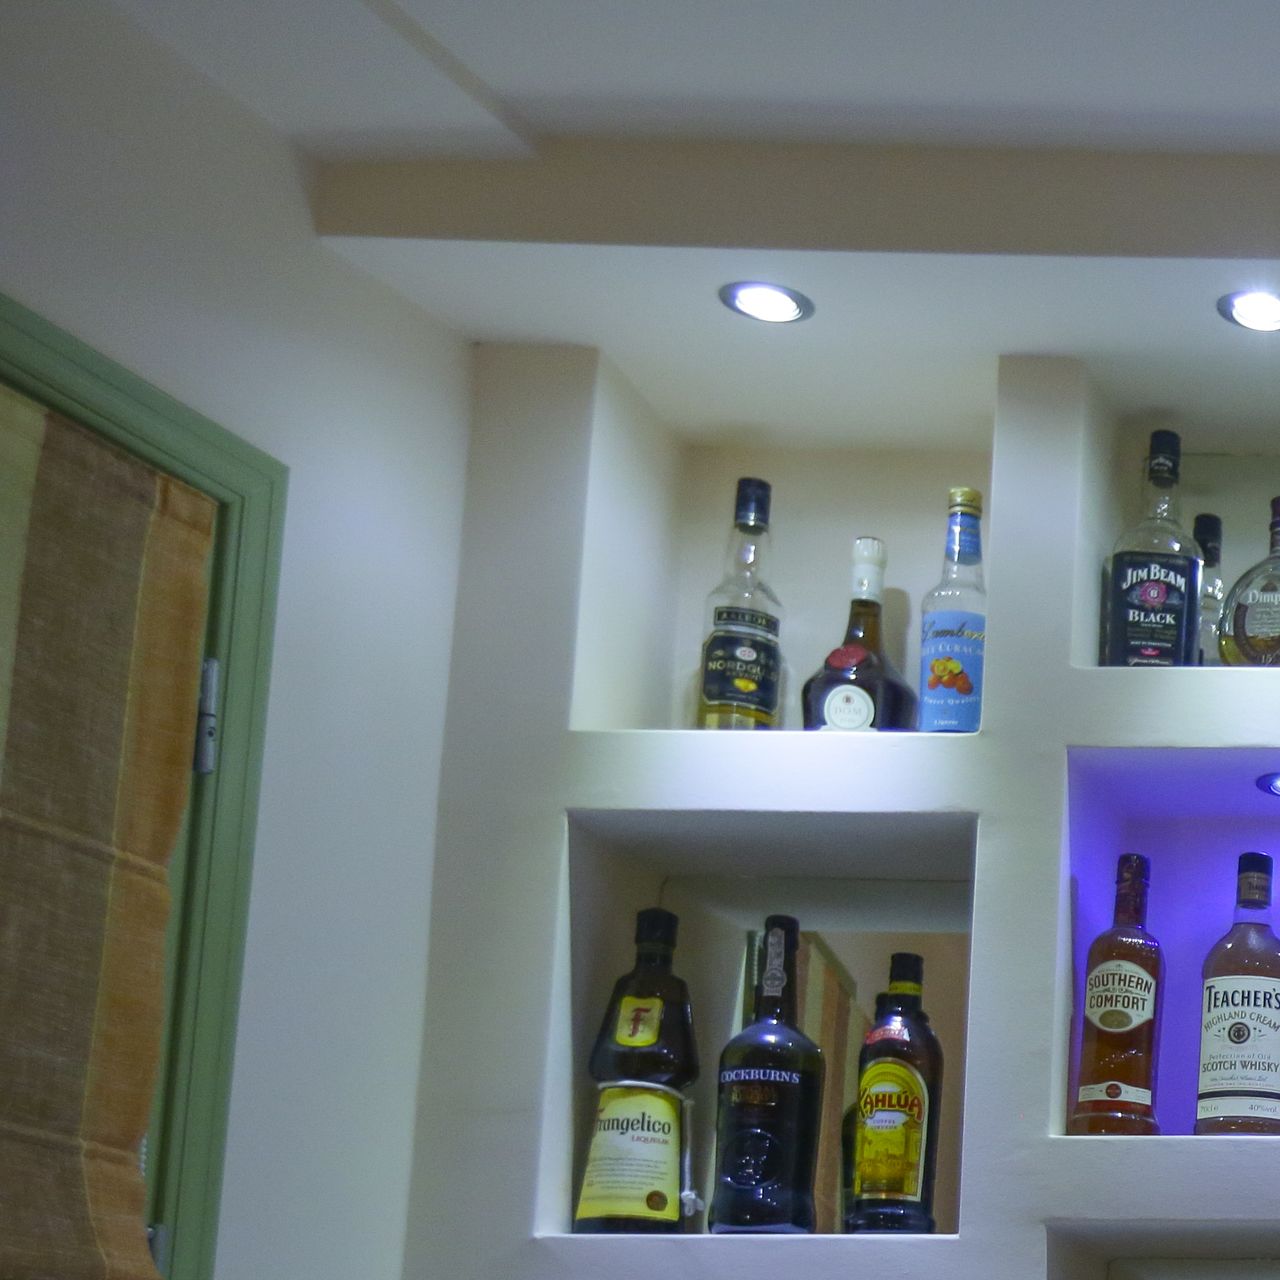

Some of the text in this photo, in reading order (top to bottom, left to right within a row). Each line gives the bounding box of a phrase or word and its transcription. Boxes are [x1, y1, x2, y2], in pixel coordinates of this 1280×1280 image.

[1122, 563, 1186, 593] JIM BEAM
[1128, 609, 1176, 624] BLACK
[1089, 973, 1153, 994] SOUTHERN
[1089, 995, 1148, 1012] COMFORT
[1204, 1011, 1280, 1032] HIGHLAND CREAM
[1202, 1060, 1279, 1073] SCOTCH WHISKY
[858, 1088, 923, 1122] KAHLÚA
[596, 1112, 671, 1135] rangelico
